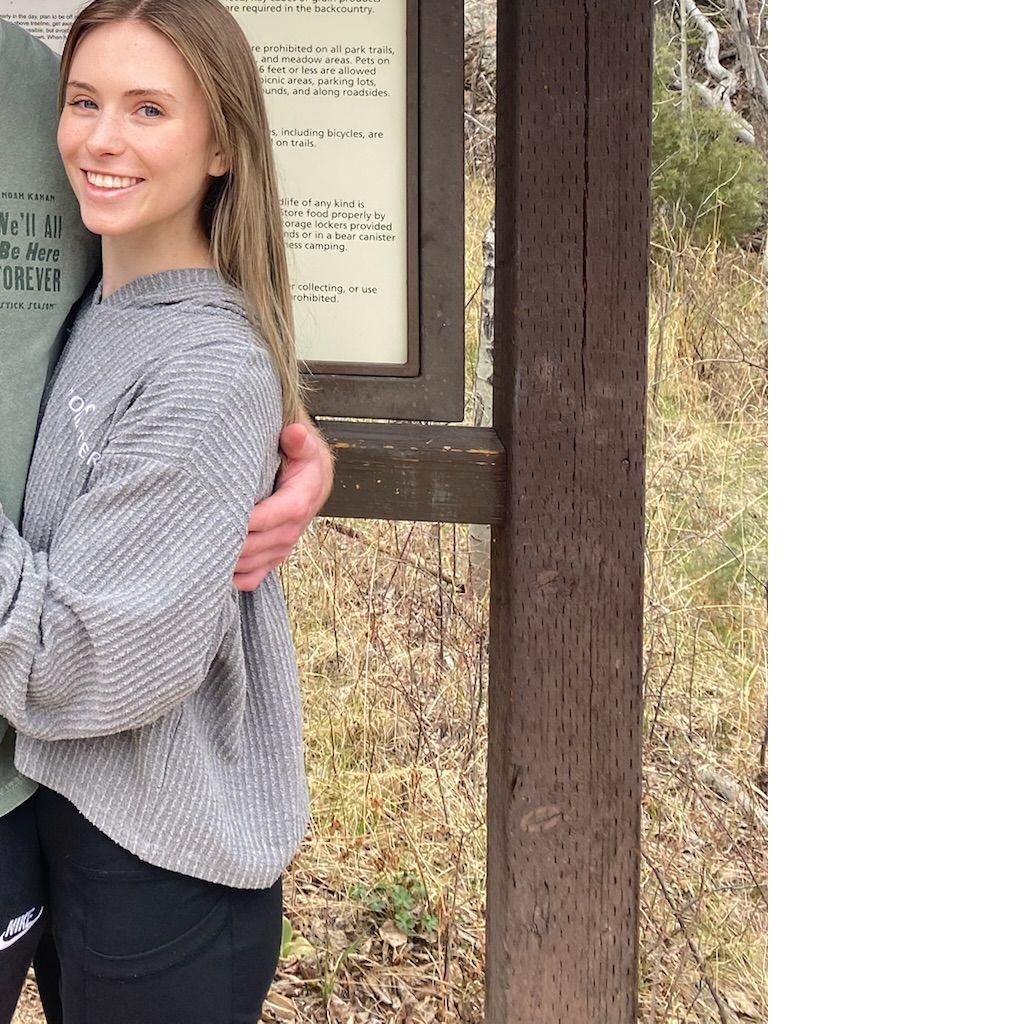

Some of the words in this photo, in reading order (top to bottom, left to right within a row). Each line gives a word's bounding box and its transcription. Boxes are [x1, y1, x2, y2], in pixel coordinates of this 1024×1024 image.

[44, 214, 62, 239] All
[26, 242, 60, 262] Here
[5, 907, 36, 938] NIKE
